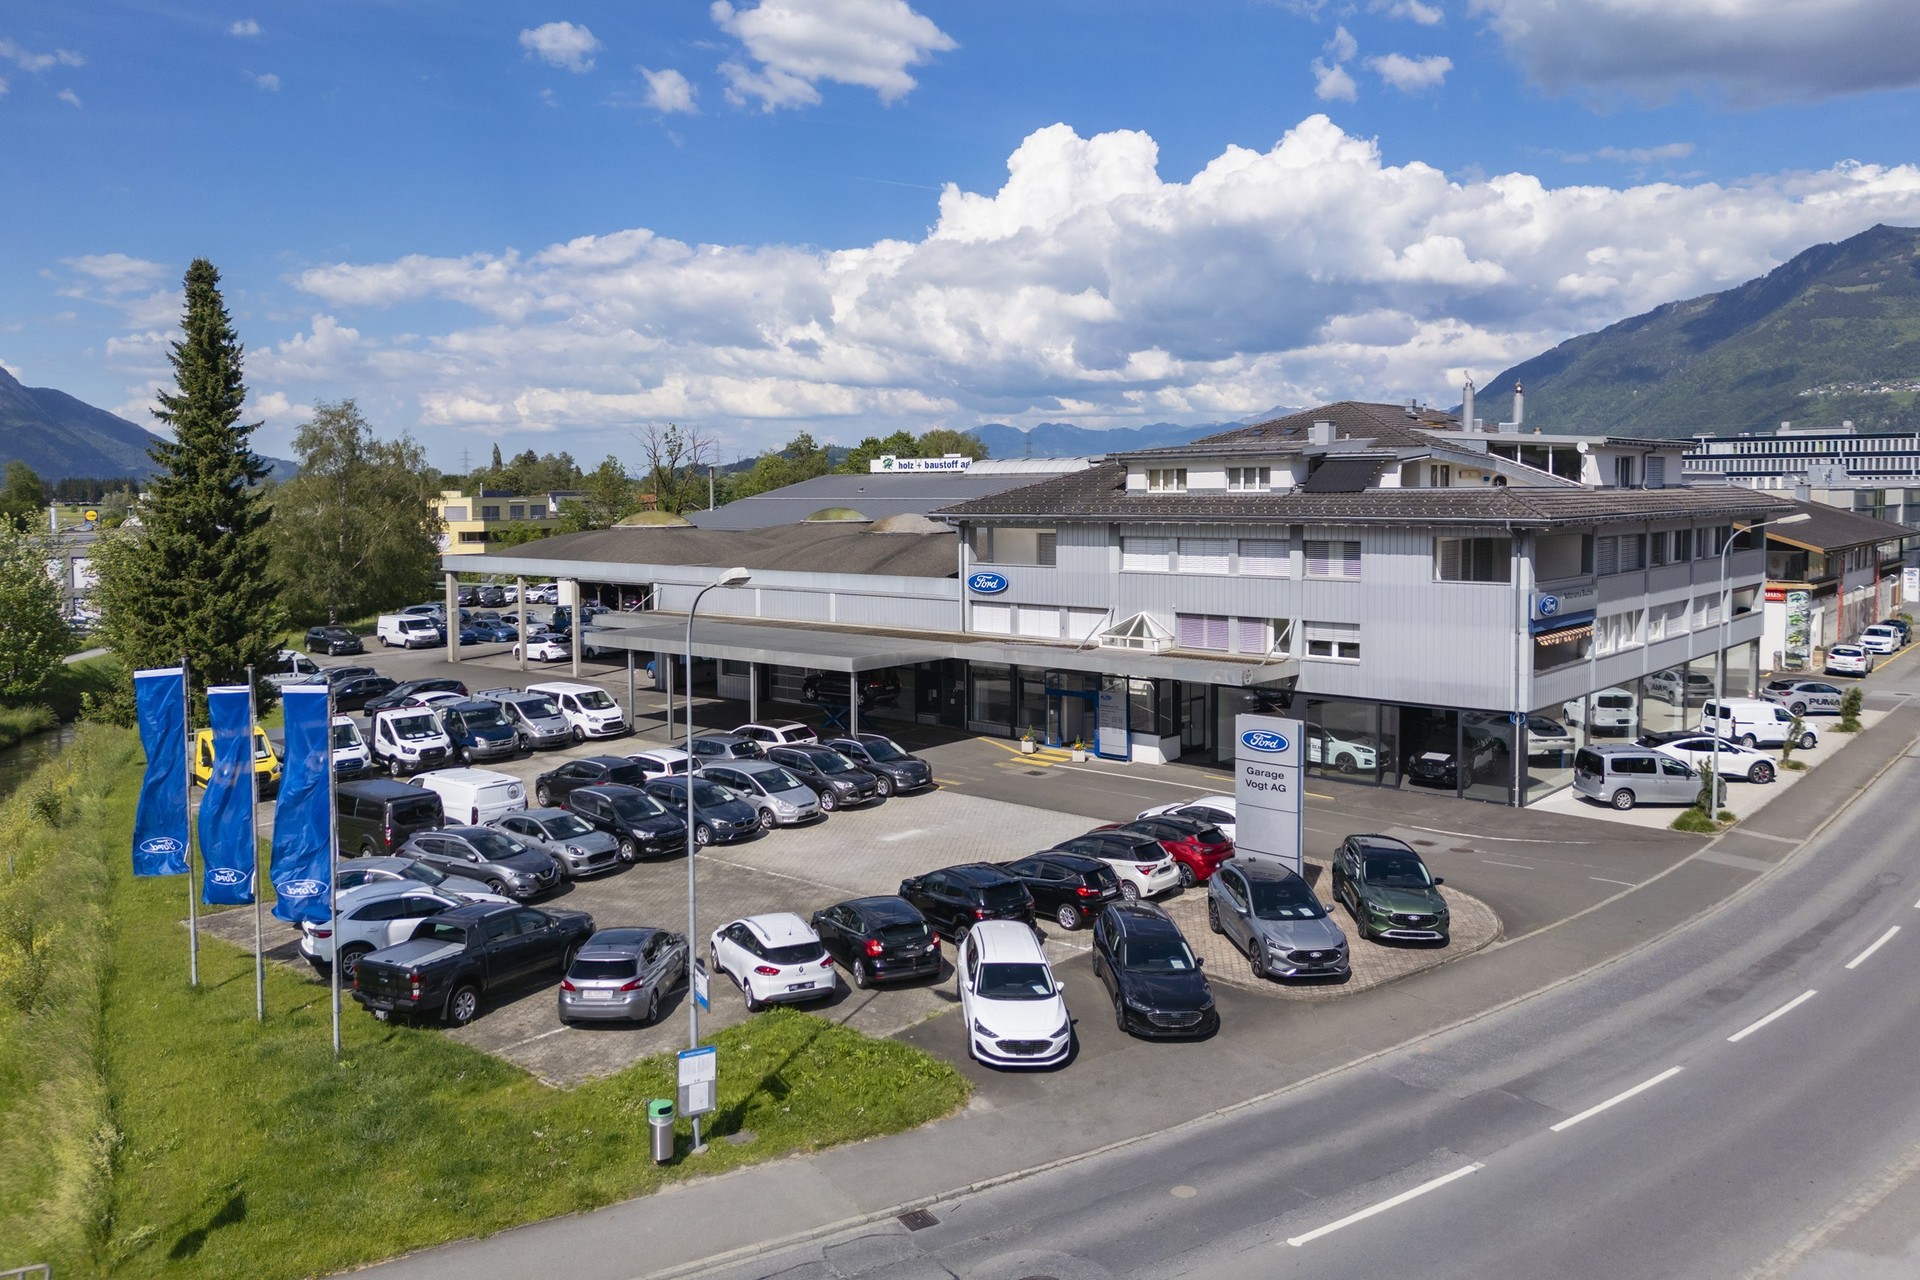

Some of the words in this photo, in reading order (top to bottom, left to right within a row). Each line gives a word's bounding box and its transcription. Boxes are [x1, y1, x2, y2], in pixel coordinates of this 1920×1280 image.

[898, 461, 914, 469] holz
[924, 460, 958, 469] baustoff
[974, 575, 999, 588] Ford
[1808, 698, 1840, 706] PUMA
[1250, 732, 1279, 748] Ford
[1246, 766, 1285, 780] Garage
[1245, 779, 1268, 791] Vogt
[1270, 783, 1287, 793] AG
